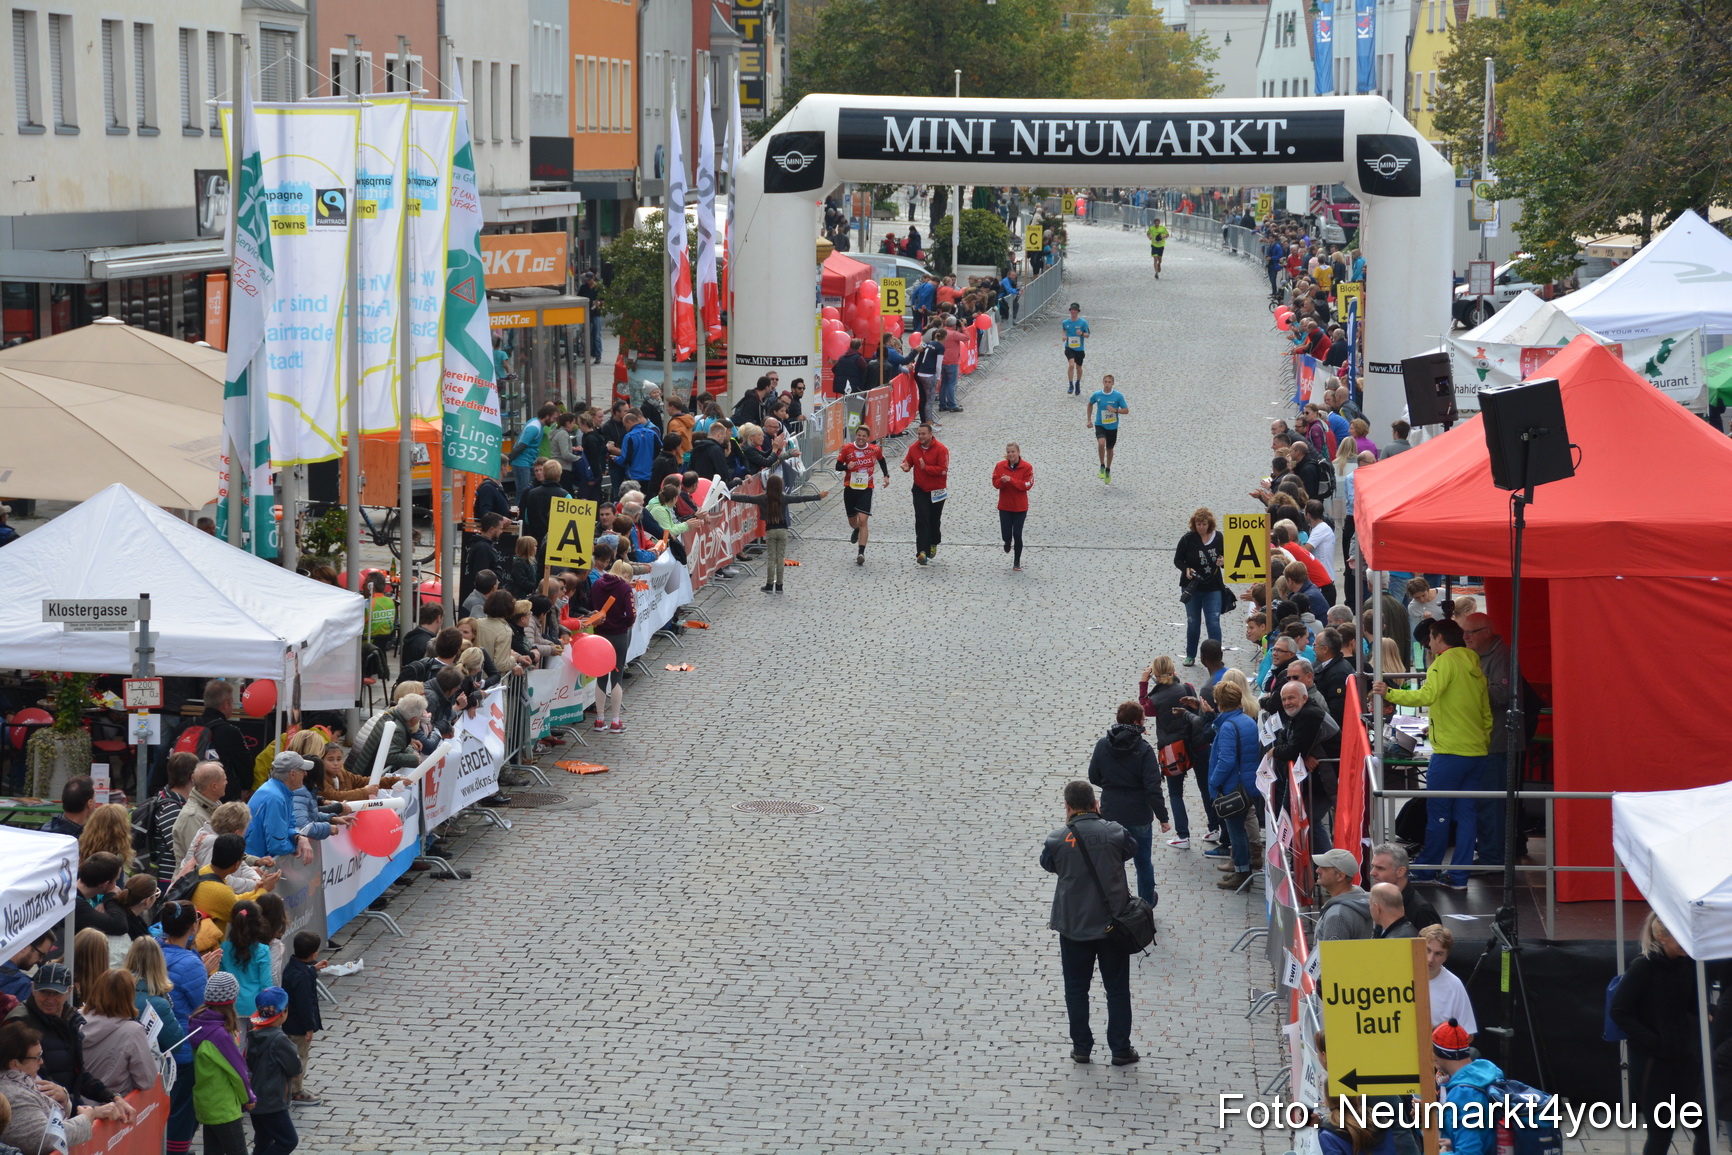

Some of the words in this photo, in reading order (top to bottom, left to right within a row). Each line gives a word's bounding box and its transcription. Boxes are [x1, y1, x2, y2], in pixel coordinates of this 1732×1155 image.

[882, 116, 996, 155] MINI
[1009, 118, 1296, 156] NEUMARKT.
[786, 157, 803, 166] MINI
[1379, 161, 1397, 170] MINI
[264, 191, 303, 202] mpagne
[1064, 200, 1072, 210] D
[267, 201, 310, 214] rtrade
[272, 219, 305, 230] Towns
[1029, 232, 1038, 246] C
[481, 248, 556, 275] RKT.DE
[883, 278, 903, 287] Block
[1339, 284, 1361, 293] Block
[290, 293, 328, 313] sind
[887, 289, 899, 307] B
[489, 314, 530, 327] ARKT.DE
[267, 322, 334, 342] airtrade
[445, 382, 464, 394] vice
[1454, 383, 1482, 395] hahid's
[444, 396, 498, 417] sterdienst
[445, 423, 499, 448] e-Line:
[557, 500, 592, 517] Block
[1229, 516, 1266, 530] Block
[556, 519, 583, 554] A
[1234, 534, 1261, 569] A
[49, 602, 128, 619] Klostergasse
[138, 681, 153, 689] 200
[4, 877, 58, 941] Neumarkt
[1289, 962, 1297, 984] swn
[1326, 980, 1416, 1010] Jugend
[1356, 1010, 1401, 1035] lauf
